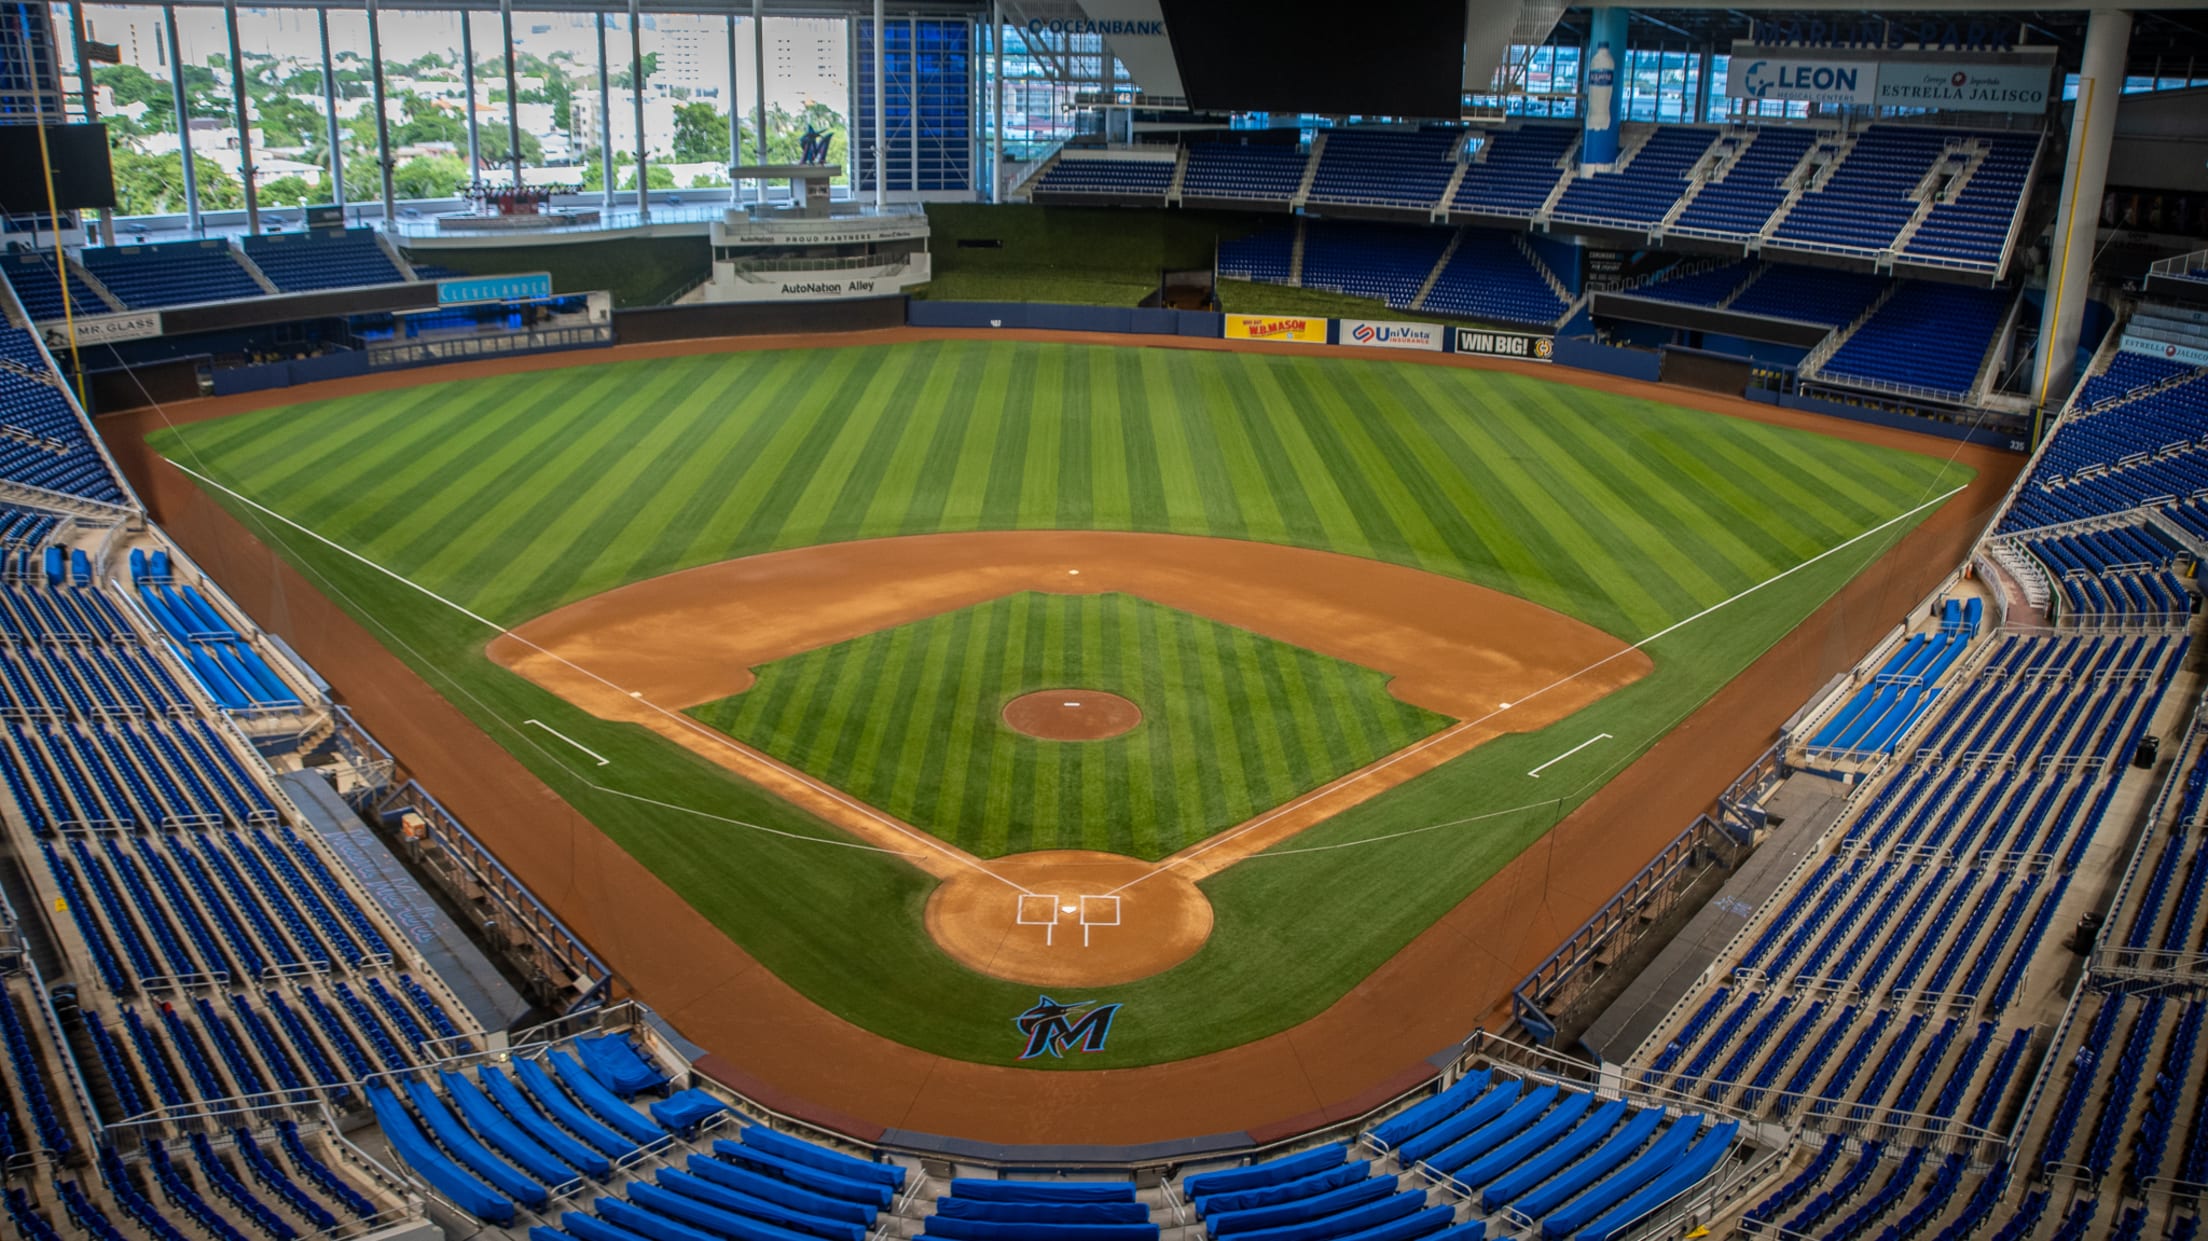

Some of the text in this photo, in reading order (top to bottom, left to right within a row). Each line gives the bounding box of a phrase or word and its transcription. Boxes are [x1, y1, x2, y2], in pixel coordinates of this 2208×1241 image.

[1050, 18, 1162, 34] OCEANBANK
[1754, 19, 2014, 52] MARLINS PARK
[1778, 65, 1857, 91] LEON
[1882, 84, 2042, 103] ESTRELLA JALISCO
[824, 233, 871, 242] PARTNERS
[440, 281, 547, 301] CLEVELANDER
[781, 280, 874, 295] AutoNation Alley
[77, 326, 104, 336] MR.
[106, 318, 154, 333] GLASS
[1461, 332, 1495, 352] WIN
[1495, 336, 1528, 355] BIG!
[2125, 340, 2165, 352] ESTRELLA
[2010, 440, 2025, 451] 335
